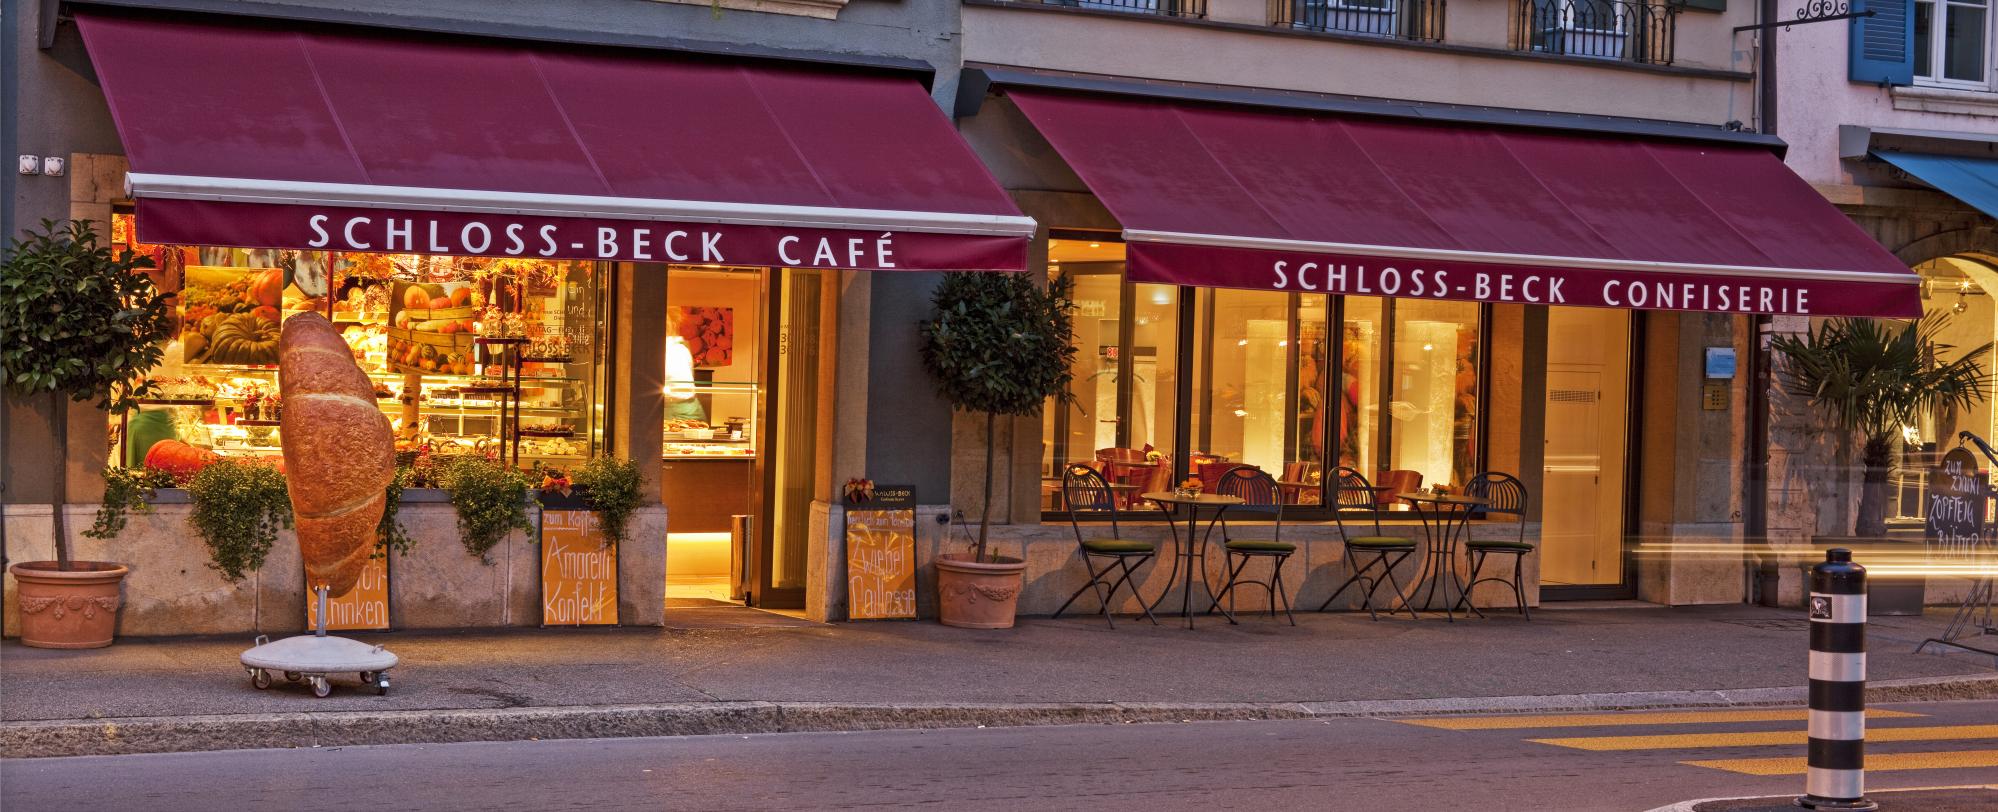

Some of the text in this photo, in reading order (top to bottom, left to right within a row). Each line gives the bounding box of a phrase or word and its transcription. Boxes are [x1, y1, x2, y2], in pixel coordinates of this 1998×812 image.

[308, 214, 896, 268] SCHLOSS-BECK CAFÉ
[1273, 260, 1809, 314] SCHLOSS-BECK CONFISERIE
[543, 513, 563, 525] zum
[309, 591, 386, 627] shinken
[544, 581, 607, 627] Konfekt
